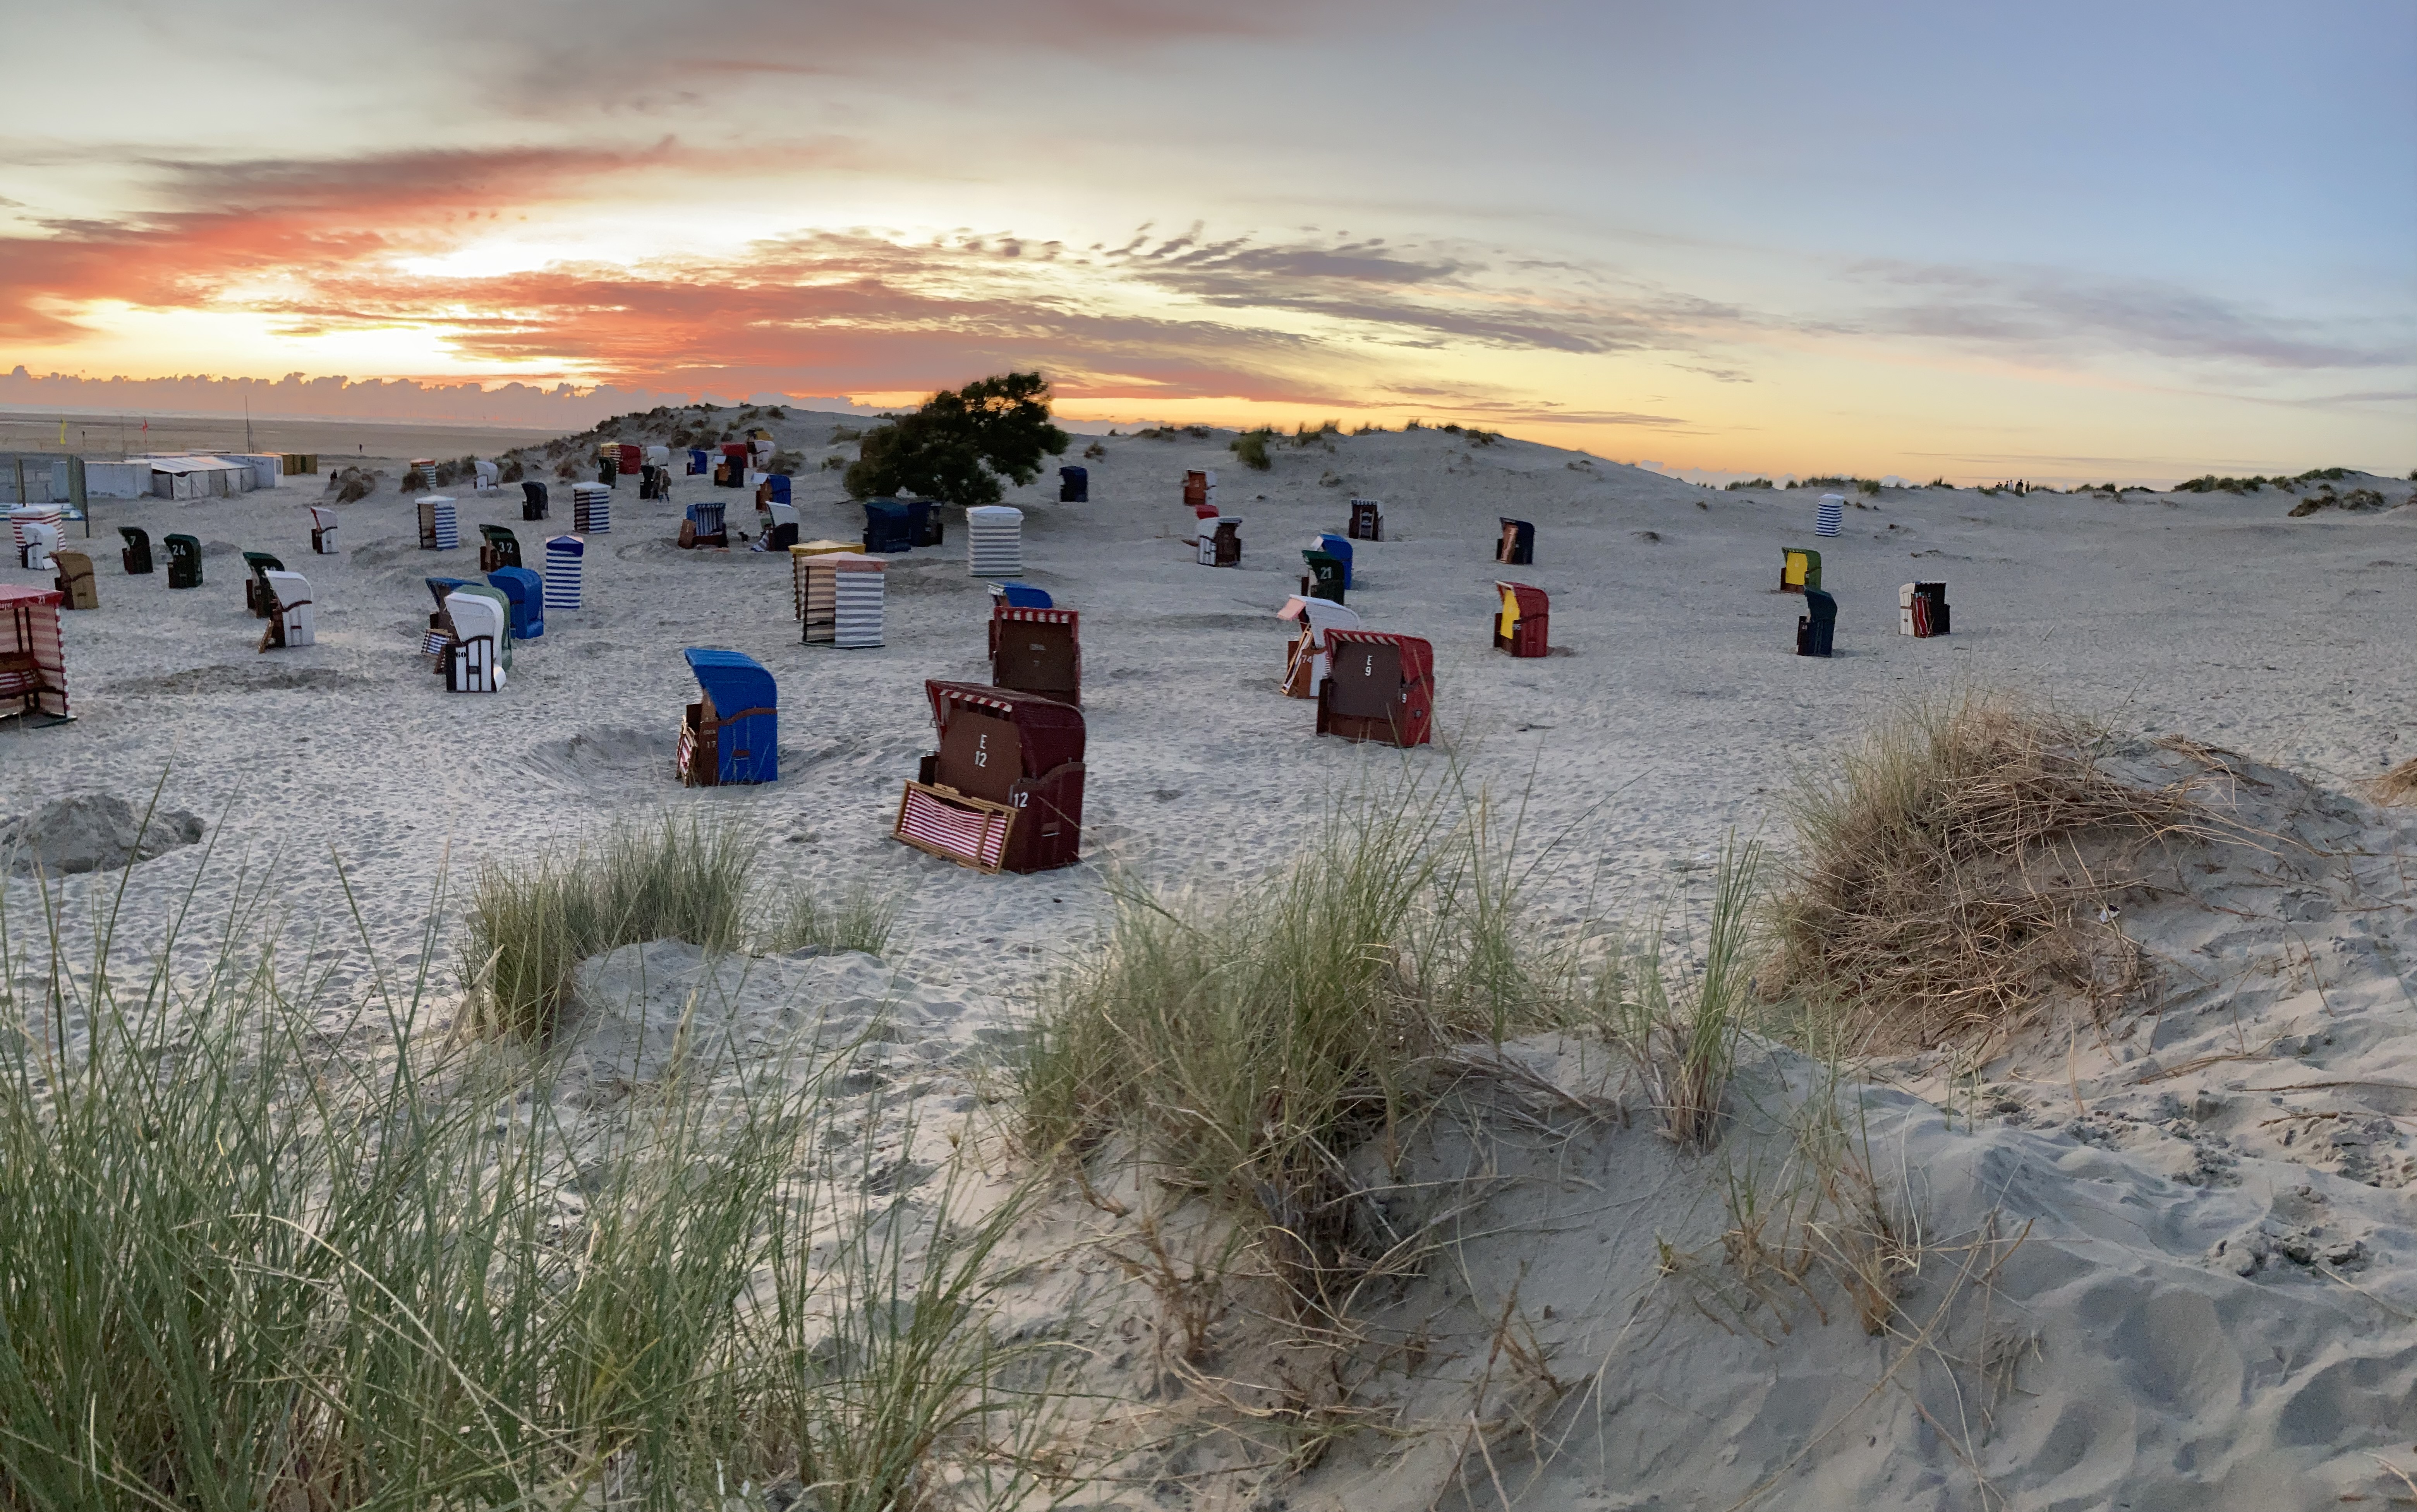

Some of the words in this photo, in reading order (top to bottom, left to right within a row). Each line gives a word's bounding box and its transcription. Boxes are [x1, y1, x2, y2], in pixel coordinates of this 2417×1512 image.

[498, 542, 513, 553] 32
[1320, 566, 1332, 579] 21
[1302, 655, 1312, 663] 74
[1367, 655, 1373, 665] E
[1365, 666, 1372, 676] 9
[980, 734, 988, 749] E
[975, 751, 987, 767] 12
[1014, 792, 1028, 808] 12
